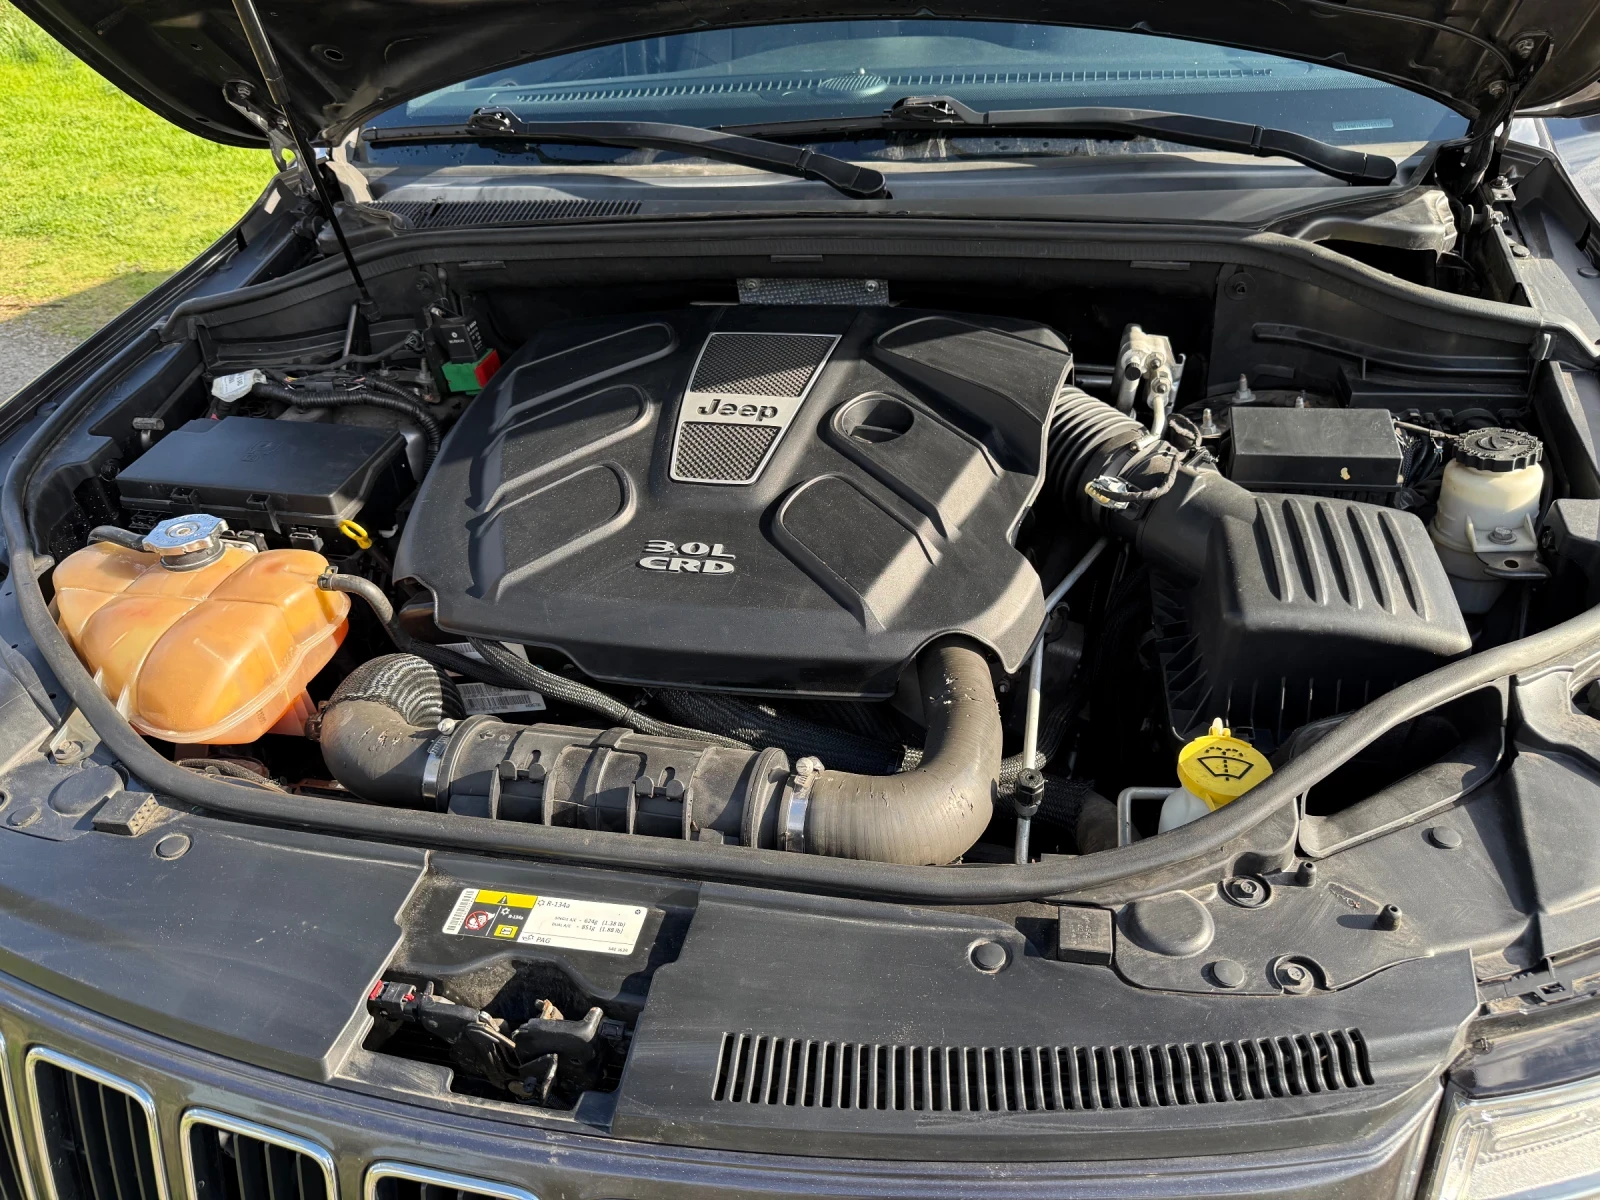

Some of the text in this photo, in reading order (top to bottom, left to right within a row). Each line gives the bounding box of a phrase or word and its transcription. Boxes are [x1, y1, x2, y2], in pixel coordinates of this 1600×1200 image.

[697, 399, 778, 422] Jeep
[642, 540, 736, 559] 3.0L
[637, 556, 735, 575] CRD
[546, 901, 571, 909] R-134a
[583, 918, 598, 926] 624g
[581, 924, 596, 932] 851g
[535, 936, 552, 944] PAG
